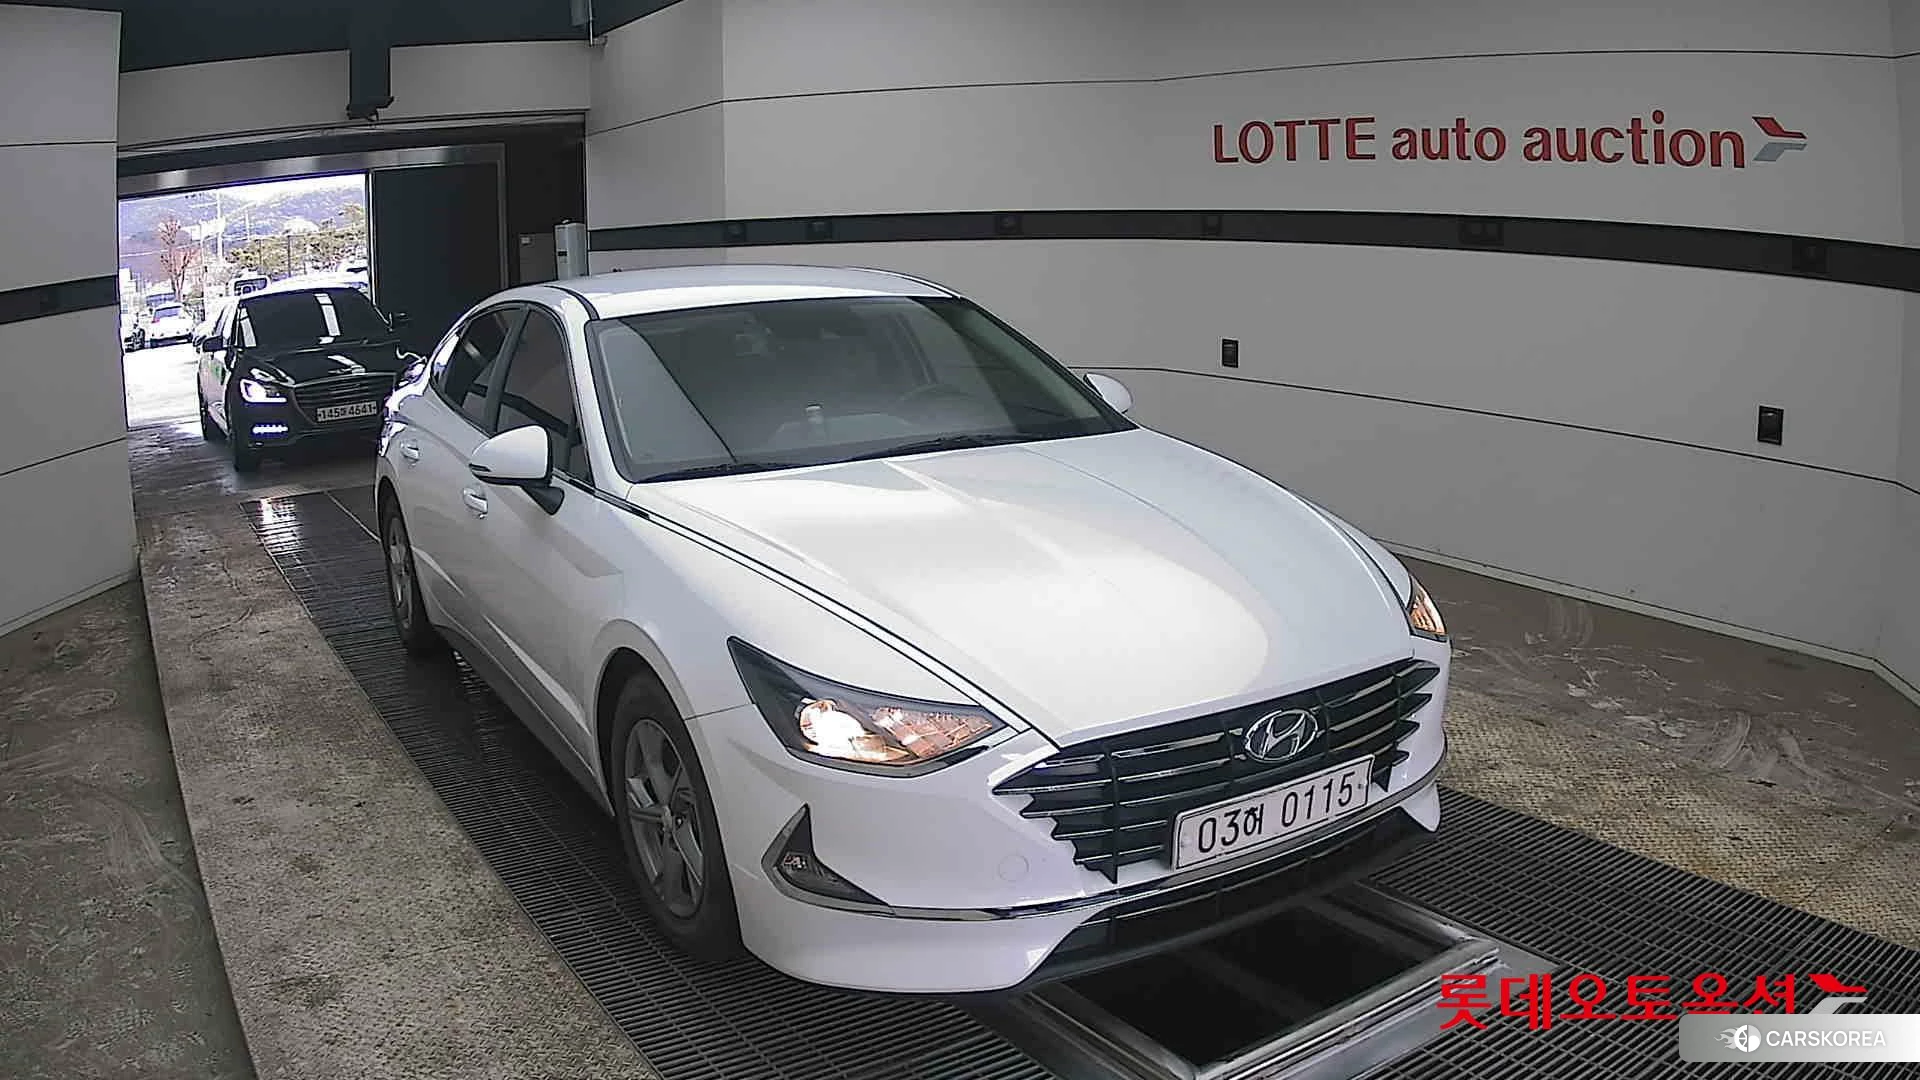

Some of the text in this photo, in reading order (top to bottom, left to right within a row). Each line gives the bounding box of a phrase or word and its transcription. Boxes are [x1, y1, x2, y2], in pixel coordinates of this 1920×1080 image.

[1213, 109, 1746, 169] LOTTE auto auction
[1198, 771, 1355, 854] 03허 0115
